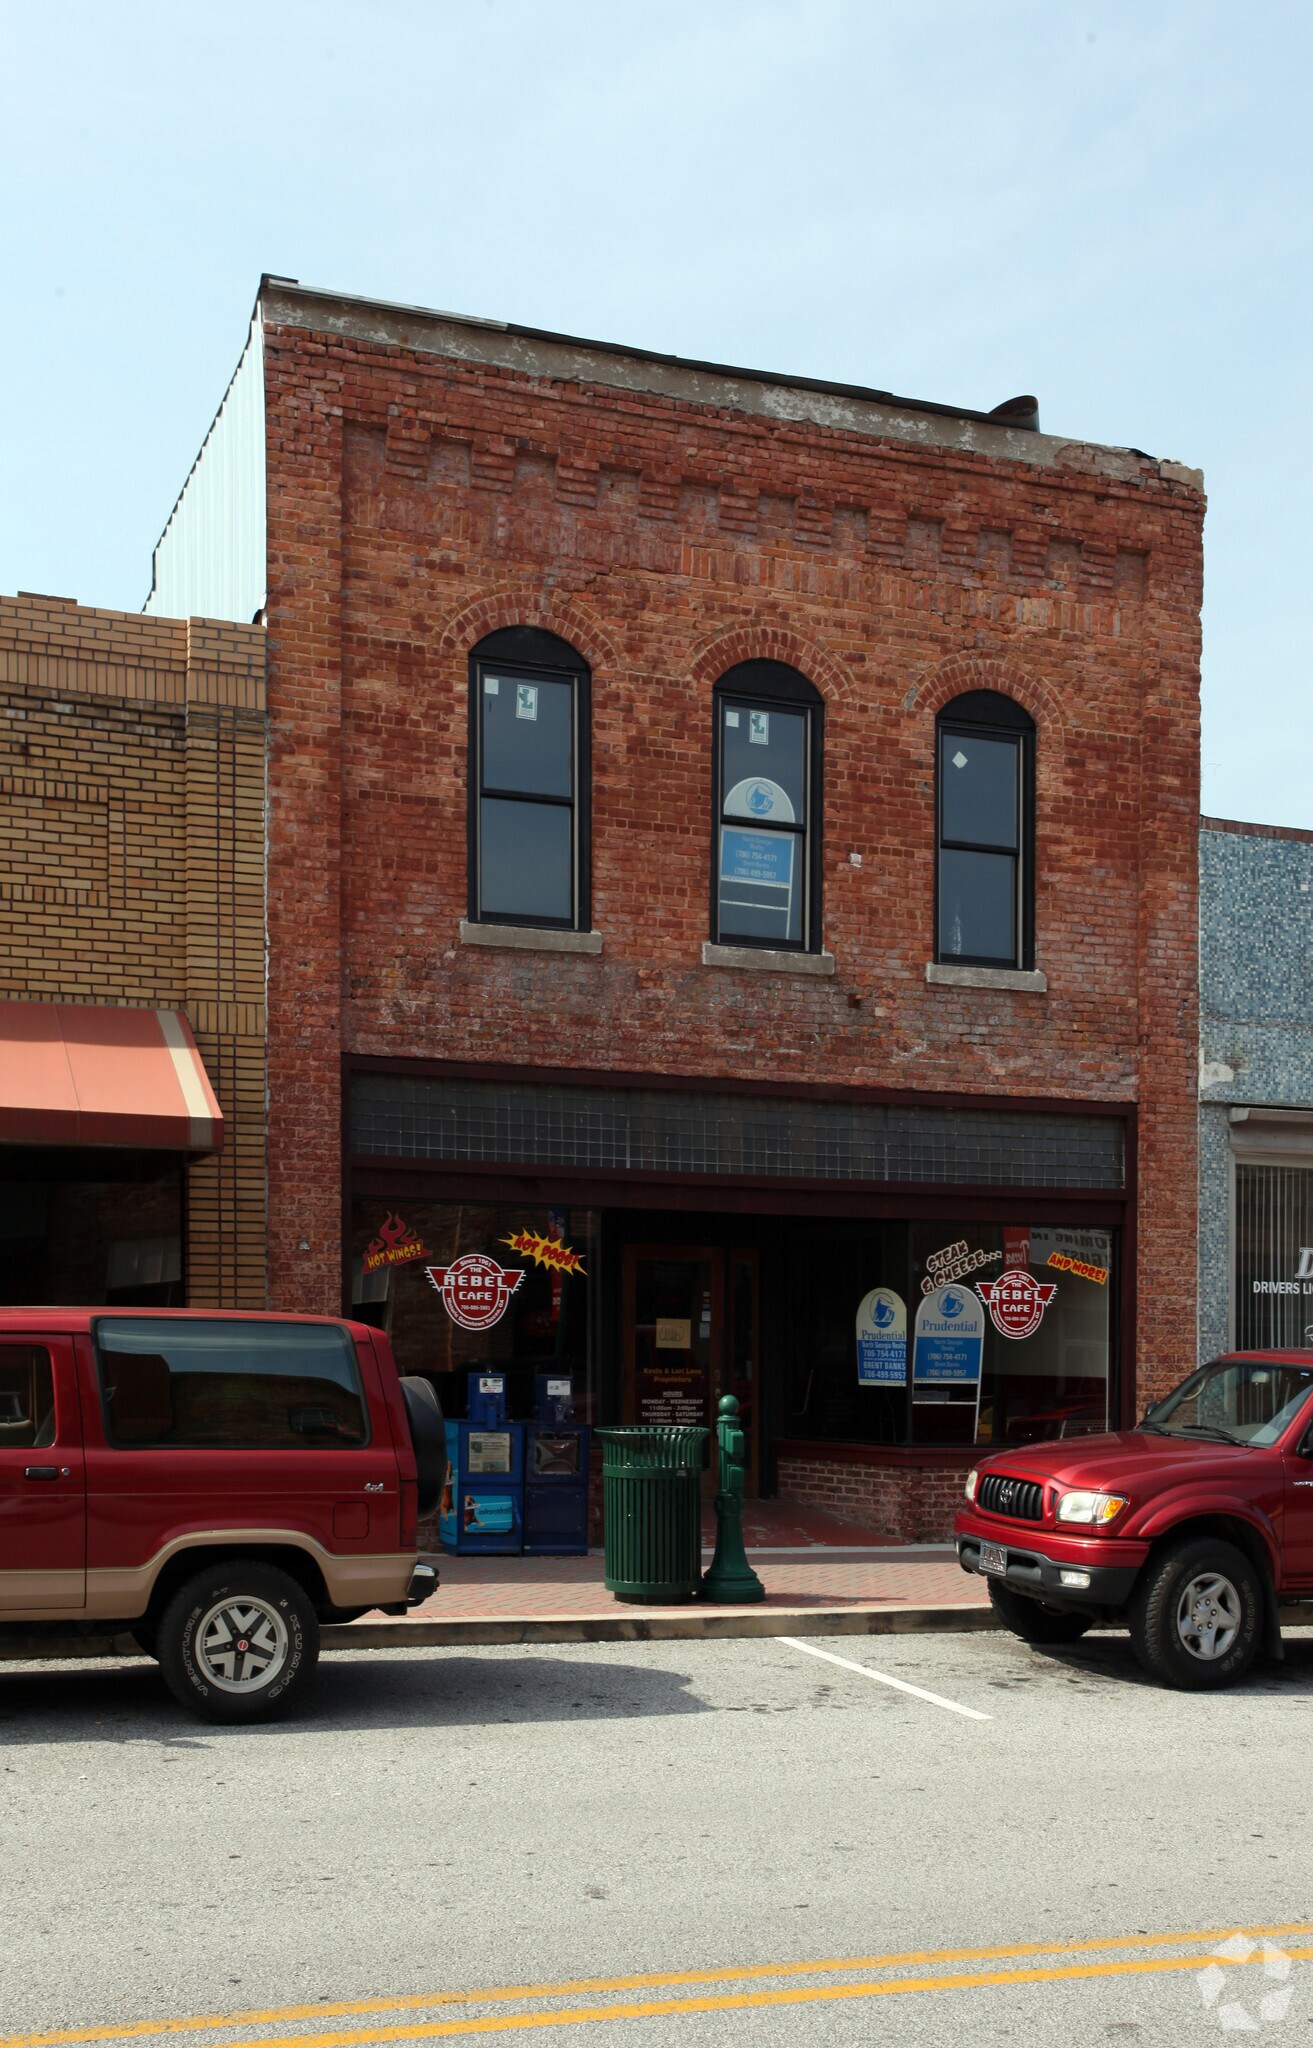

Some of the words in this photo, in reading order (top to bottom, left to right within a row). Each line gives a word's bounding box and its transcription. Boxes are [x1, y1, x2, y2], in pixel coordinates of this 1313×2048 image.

[367, 1253, 385, 1268] HOT
[386, 1244, 421, 1261] WINGS!
[514, 1236, 540, 1253] HOT
[541, 1245, 579, 1268] DOGS!
[927, 1240, 968, 1272] STEAK
[460, 1258, 476, 1267] Since
[1047, 1251, 1072, 1270] AND
[1071, 1259, 1109, 1285] MORE!
[444, 1275, 507, 1287] REBEL
[921, 1276, 934, 1294] &
[1253, 1281, 1300, 1294] DRIVERS
[459, 1291, 492, 1300] CAFE
[990, 1290, 1043, 1300] REBEL
[1002, 1304, 1030, 1312] CAFE
[922, 1320, 977, 1332] Prudential
[861, 1330, 906, 1340] Prudential
[892, 1342, 906, 1350] Realty
[864, 1350, 906, 1358] 706-754-4171
[885, 1362, 906, 1370] BANKS
[864, 1371, 906, 1379] 706-499-5957
[364, 1483, 384, 1492] 4x4
[182, 1606, 208, 1696] VENTURE
[268, 1614, 303, 1698] KUMHO
